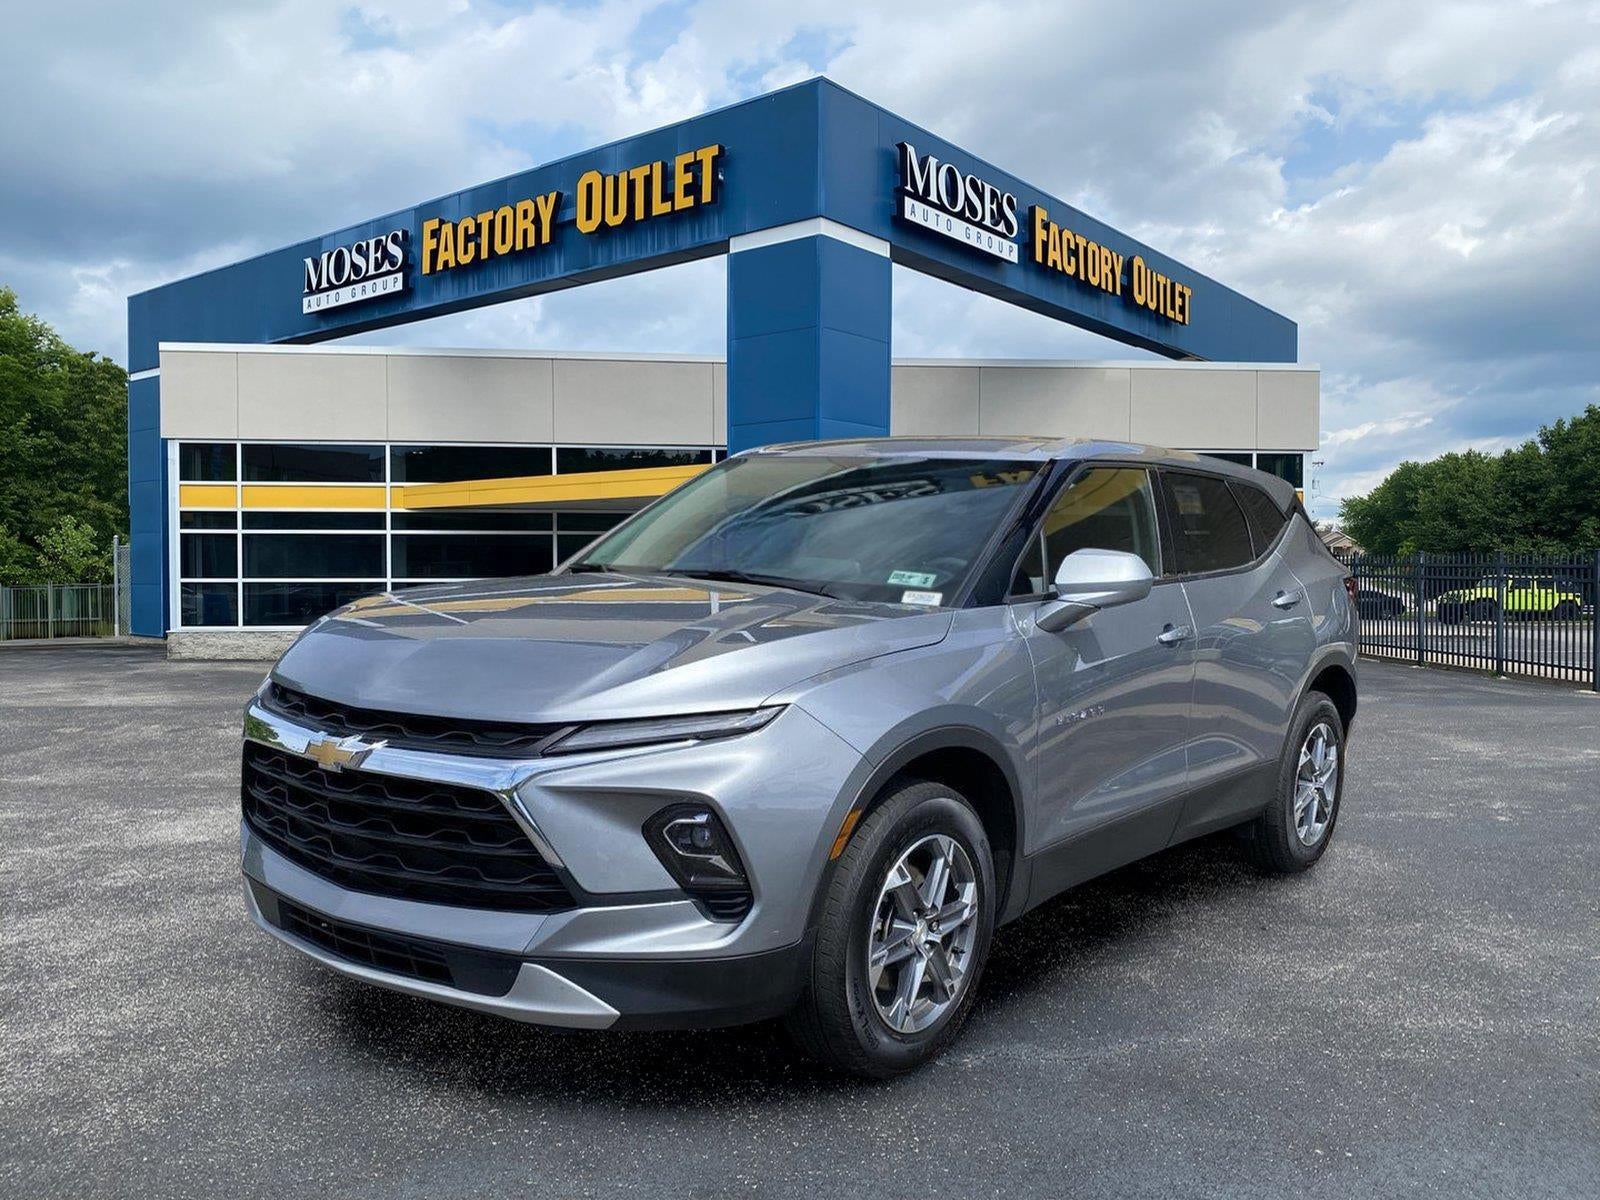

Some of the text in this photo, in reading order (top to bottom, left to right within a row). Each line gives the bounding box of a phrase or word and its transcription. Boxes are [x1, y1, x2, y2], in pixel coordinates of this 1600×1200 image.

[421, 144, 720, 275] FACTORY OUTLET
[903, 141, 1018, 238] MOSES
[302, 229, 403, 293] MOSES
[910, 203, 1014, 257] AUTO GROUP
[1034, 204, 1192, 325] FACTORY OUTLET
[307, 276, 399, 309] AUTO GROUP
